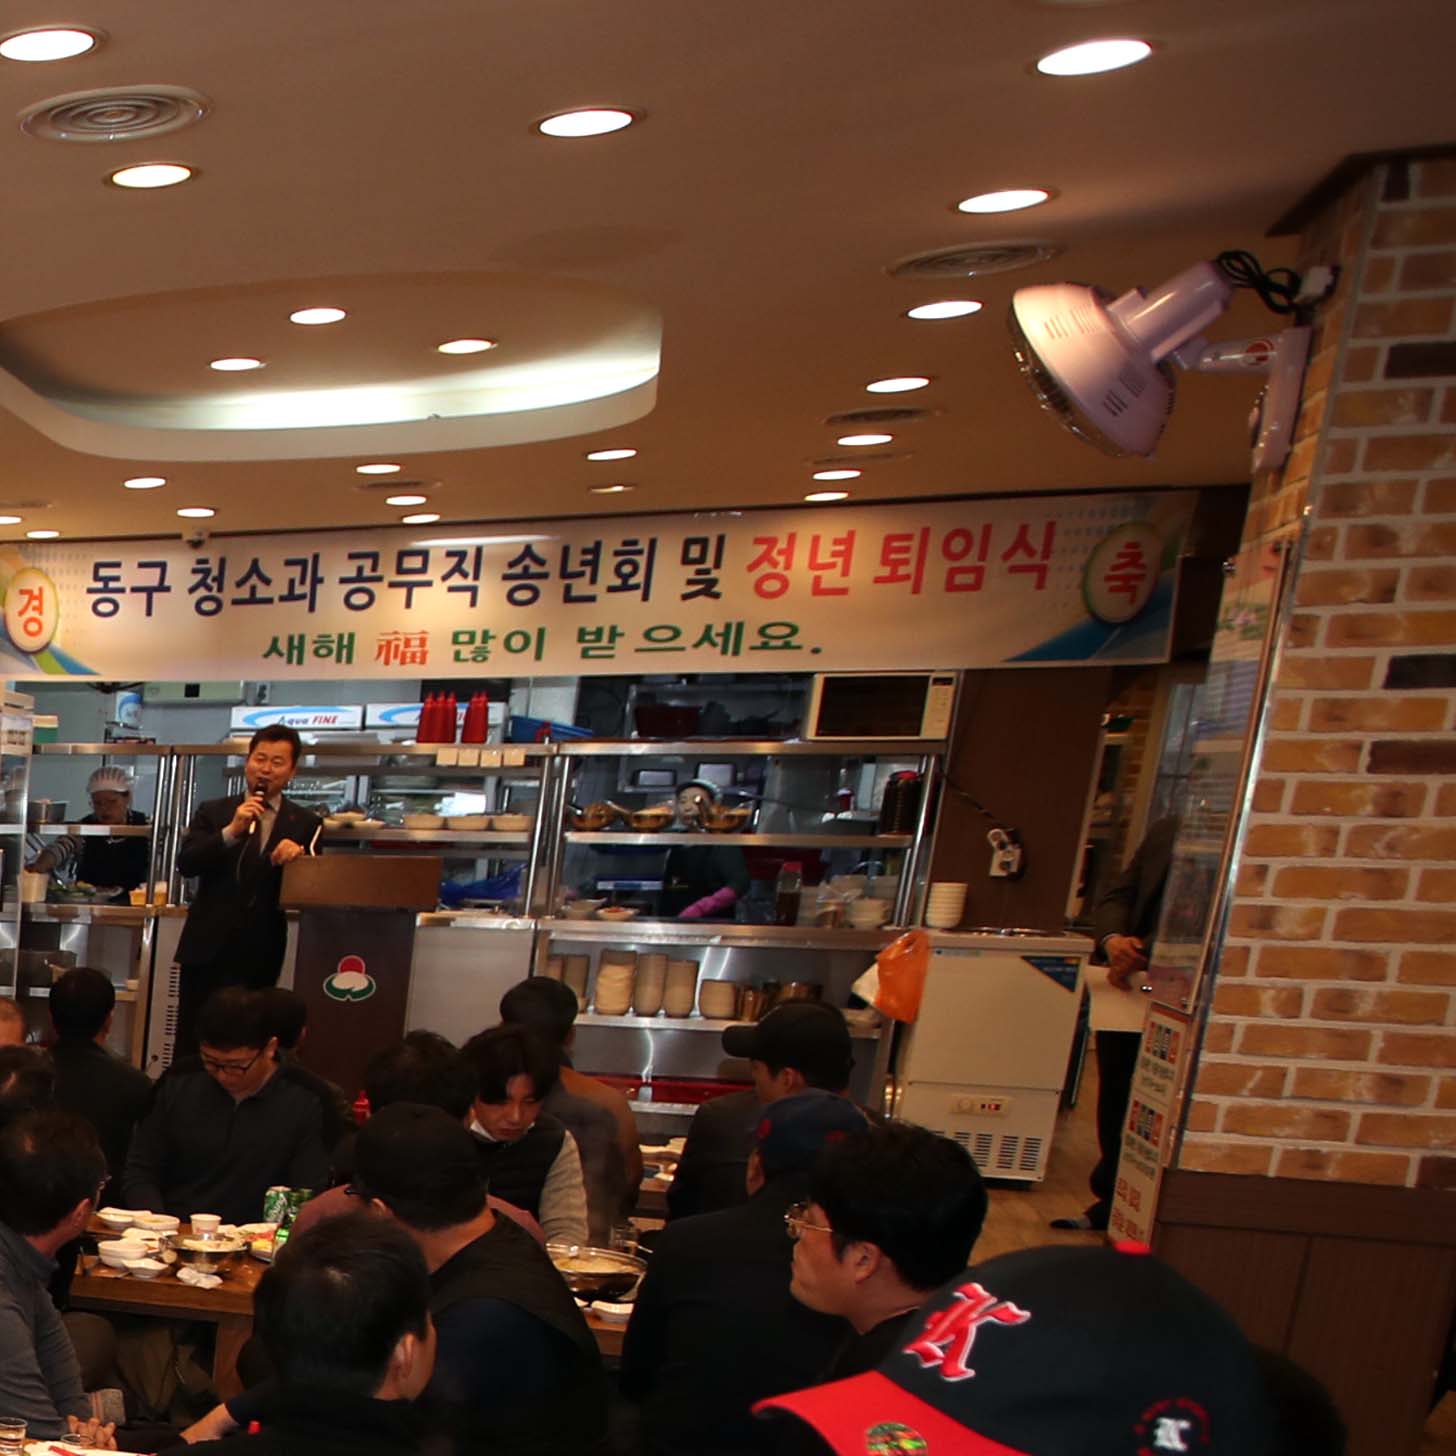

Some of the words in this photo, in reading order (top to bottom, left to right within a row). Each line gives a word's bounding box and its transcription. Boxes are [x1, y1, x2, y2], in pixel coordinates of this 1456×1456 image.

[86, 561, 171, 618] 동구
[188, 553, 324, 617] 청소과
[338, 544, 483, 611] 공무직
[501, 537, 657, 606] 송년회
[681, 534, 726, 601] 및
[746, 529, 856, 600] 정년
[873, 521, 1057, 595] 퇴임식
[1104, 541, 1146, 605] 축
[18, 586, 45, 638] 경
[262, 631, 355, 665] 새해
[375, 629, 430, 666] 福
[451, 626, 546, 663] 많이
[311, 715, 339, 725] FINE
[902, 1281, 1032, 1383] K
